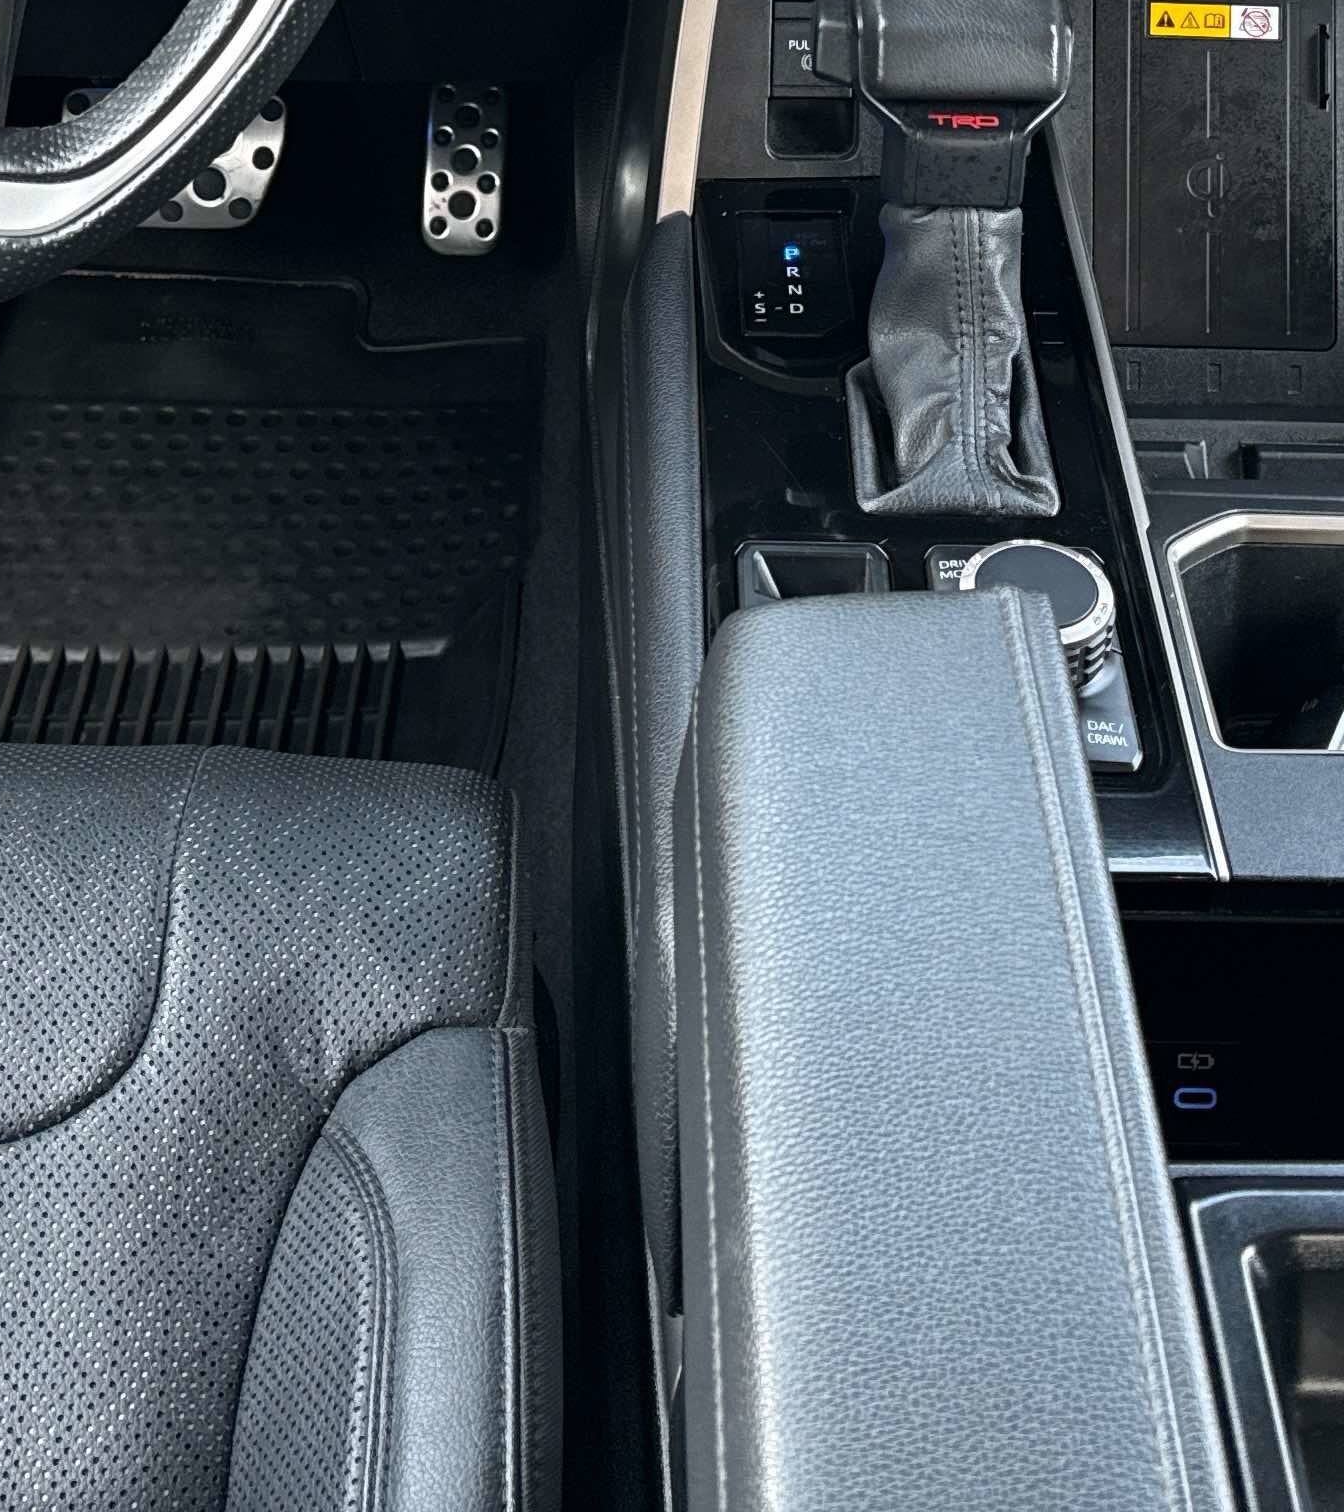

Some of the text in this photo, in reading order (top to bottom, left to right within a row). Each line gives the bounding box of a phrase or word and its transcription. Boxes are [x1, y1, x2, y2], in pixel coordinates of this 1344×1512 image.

[927, 113, 1000, 131] TRD
[784, 246, 800, 260] P
[786, 266, 800, 277] R
[788, 284, 802, 296] N
[755, 302, 804, 315] S D
